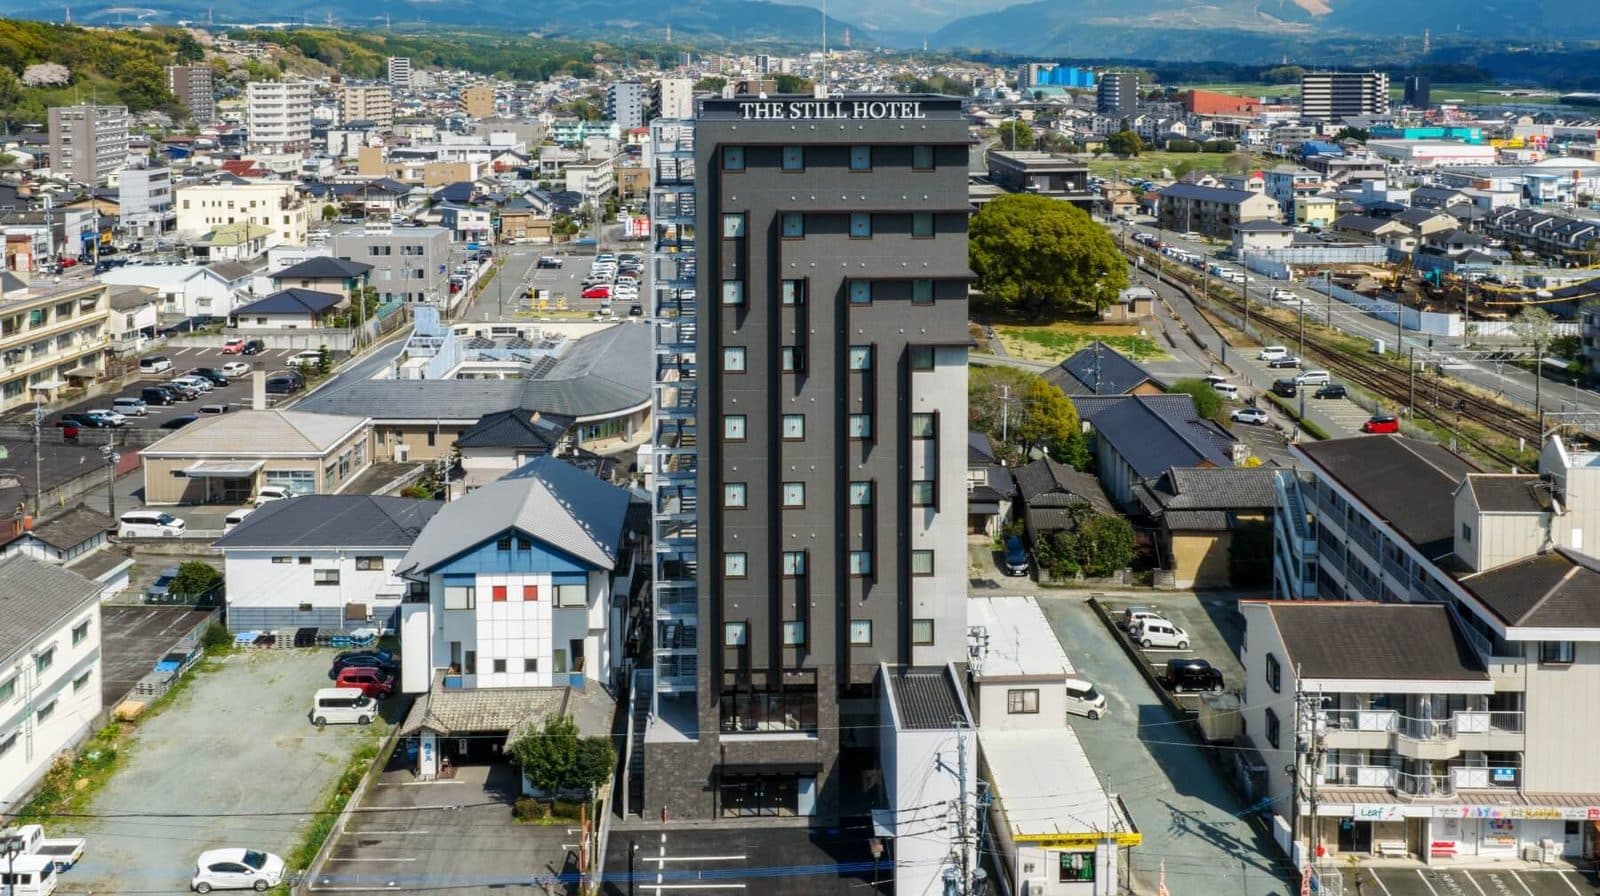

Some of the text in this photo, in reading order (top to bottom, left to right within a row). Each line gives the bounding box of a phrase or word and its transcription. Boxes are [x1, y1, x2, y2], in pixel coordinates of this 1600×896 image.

[739, 101, 926, 119] THE STILL HOTEL
[1360, 806, 1384, 818] Leaf
